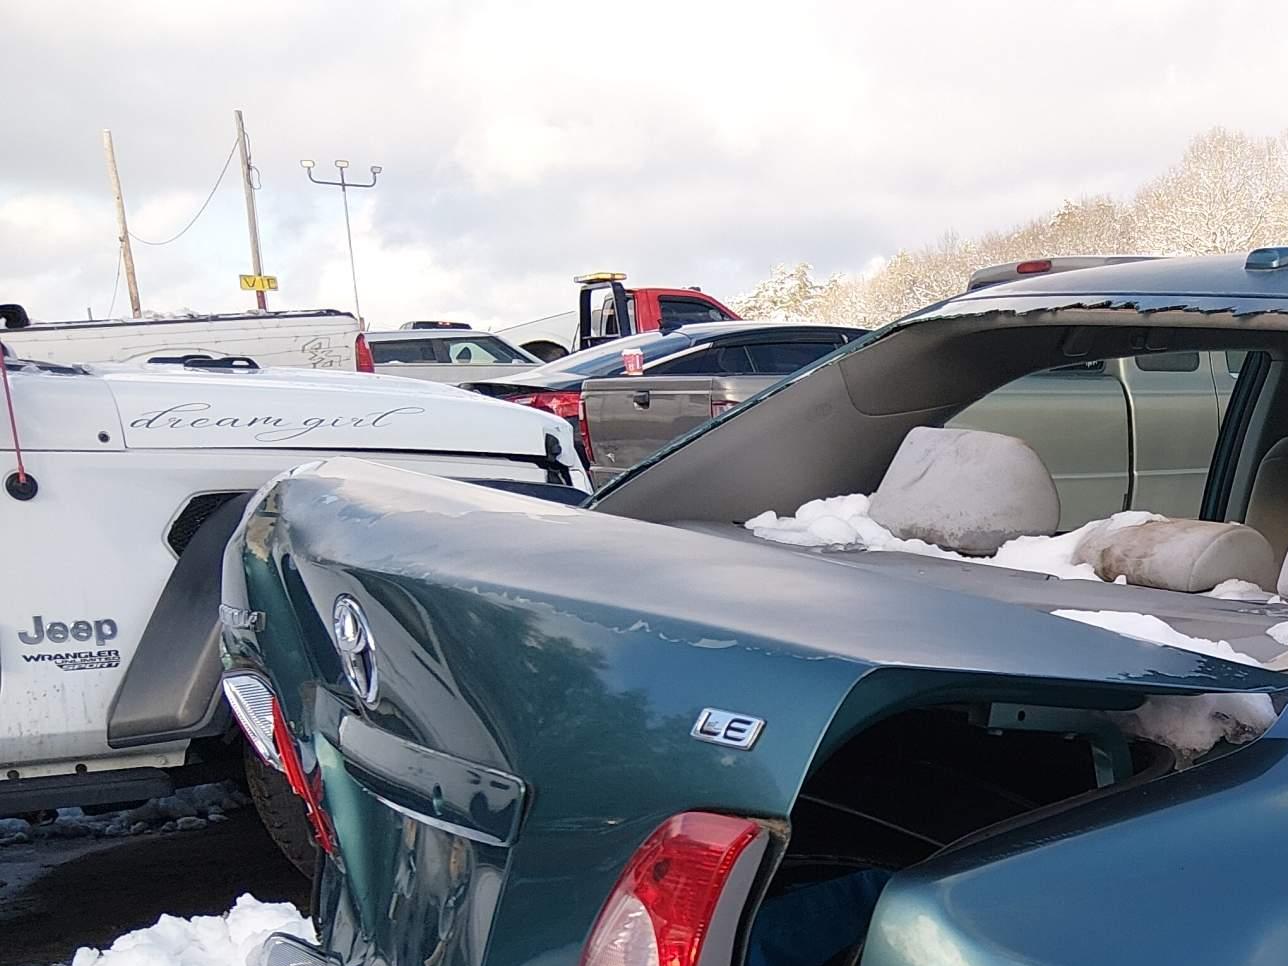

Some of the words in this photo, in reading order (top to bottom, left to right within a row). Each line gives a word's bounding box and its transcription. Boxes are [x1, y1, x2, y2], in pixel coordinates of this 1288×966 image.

[130, 403, 292, 428] dream
[255, 407, 424, 441] girl
[18, 616, 118, 646] Jeep
[22, 649, 119, 662] WRANGLER
[54, 656, 120, 665] UNLIMITED
[56, 662, 120, 671] SPORT
[697, 711, 754, 742] LE
